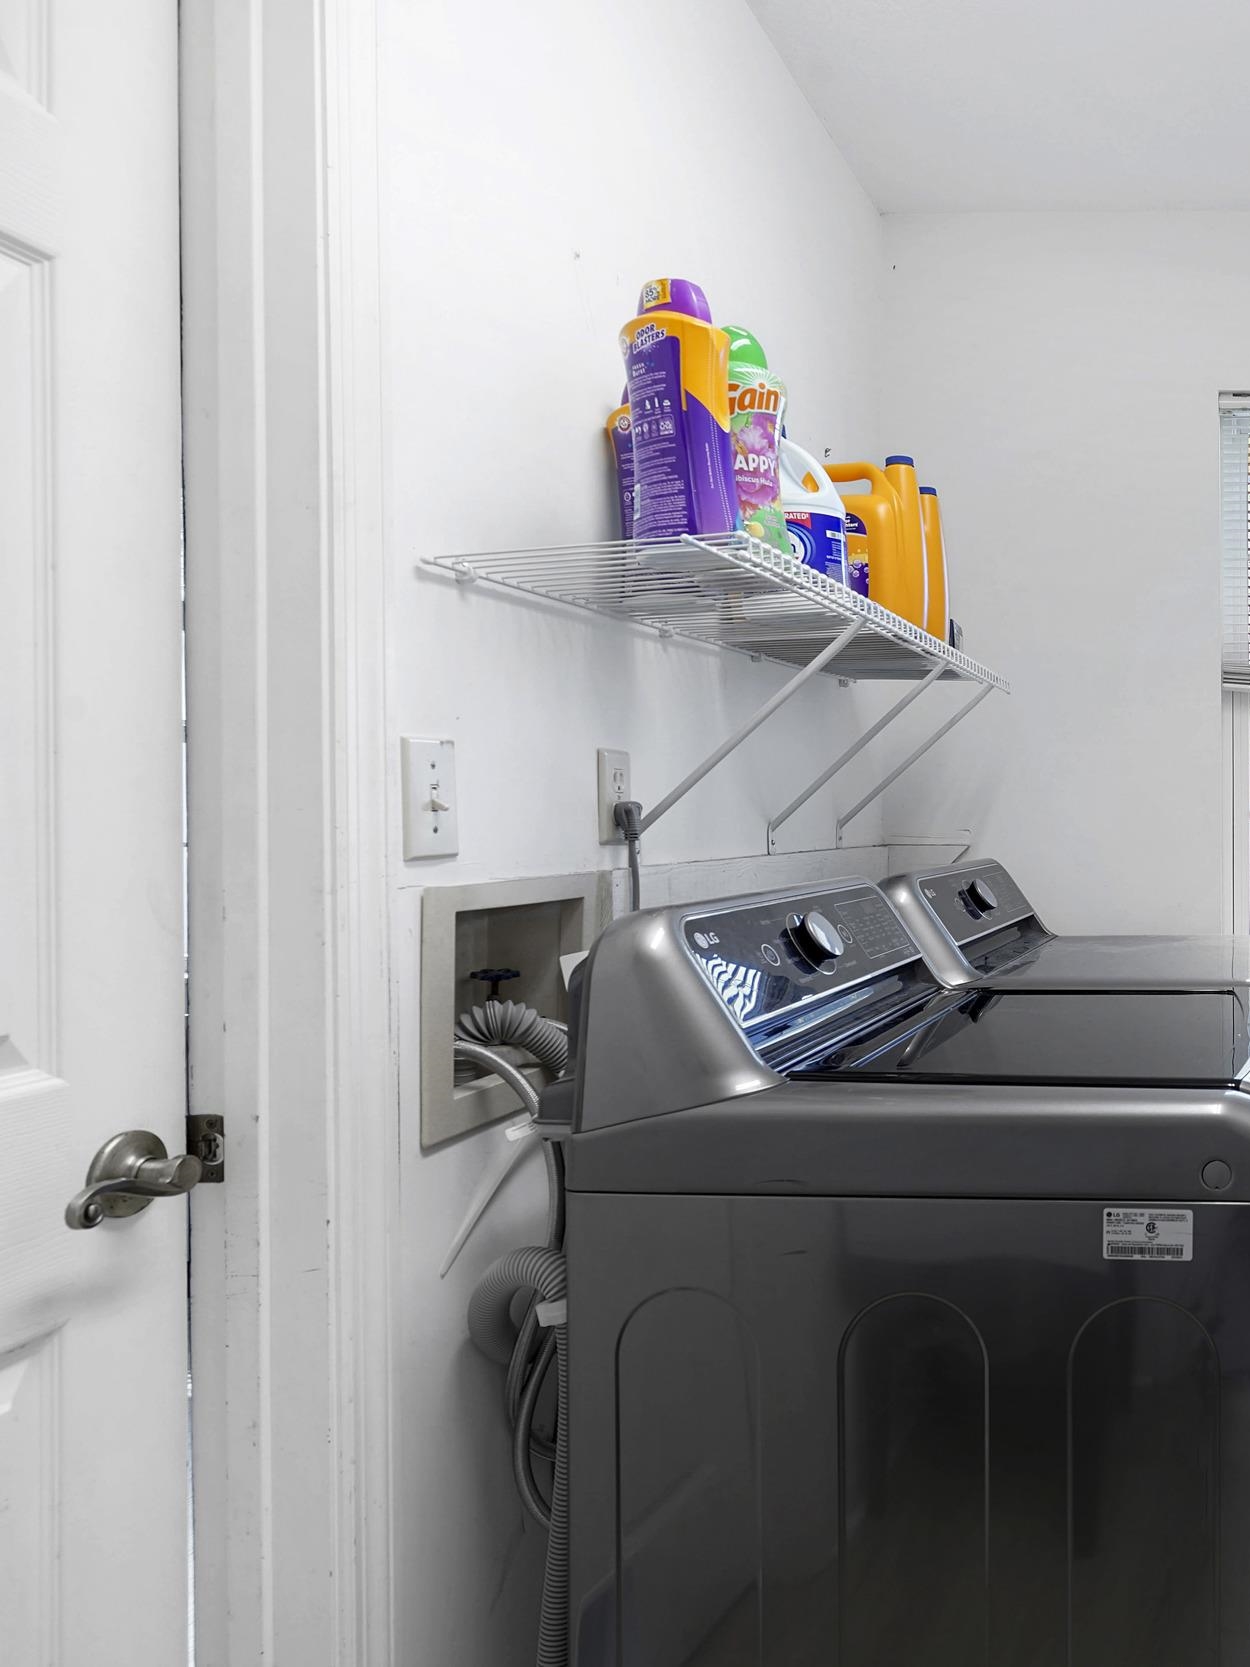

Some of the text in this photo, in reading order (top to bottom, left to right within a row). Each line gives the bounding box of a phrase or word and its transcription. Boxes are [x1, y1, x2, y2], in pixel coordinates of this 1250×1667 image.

[633, 330, 666, 353] BLASTERS
[635, 324, 655, 341] ODOR
[733, 453, 776, 477] APPY
[735, 475, 760, 484] ibiscus
